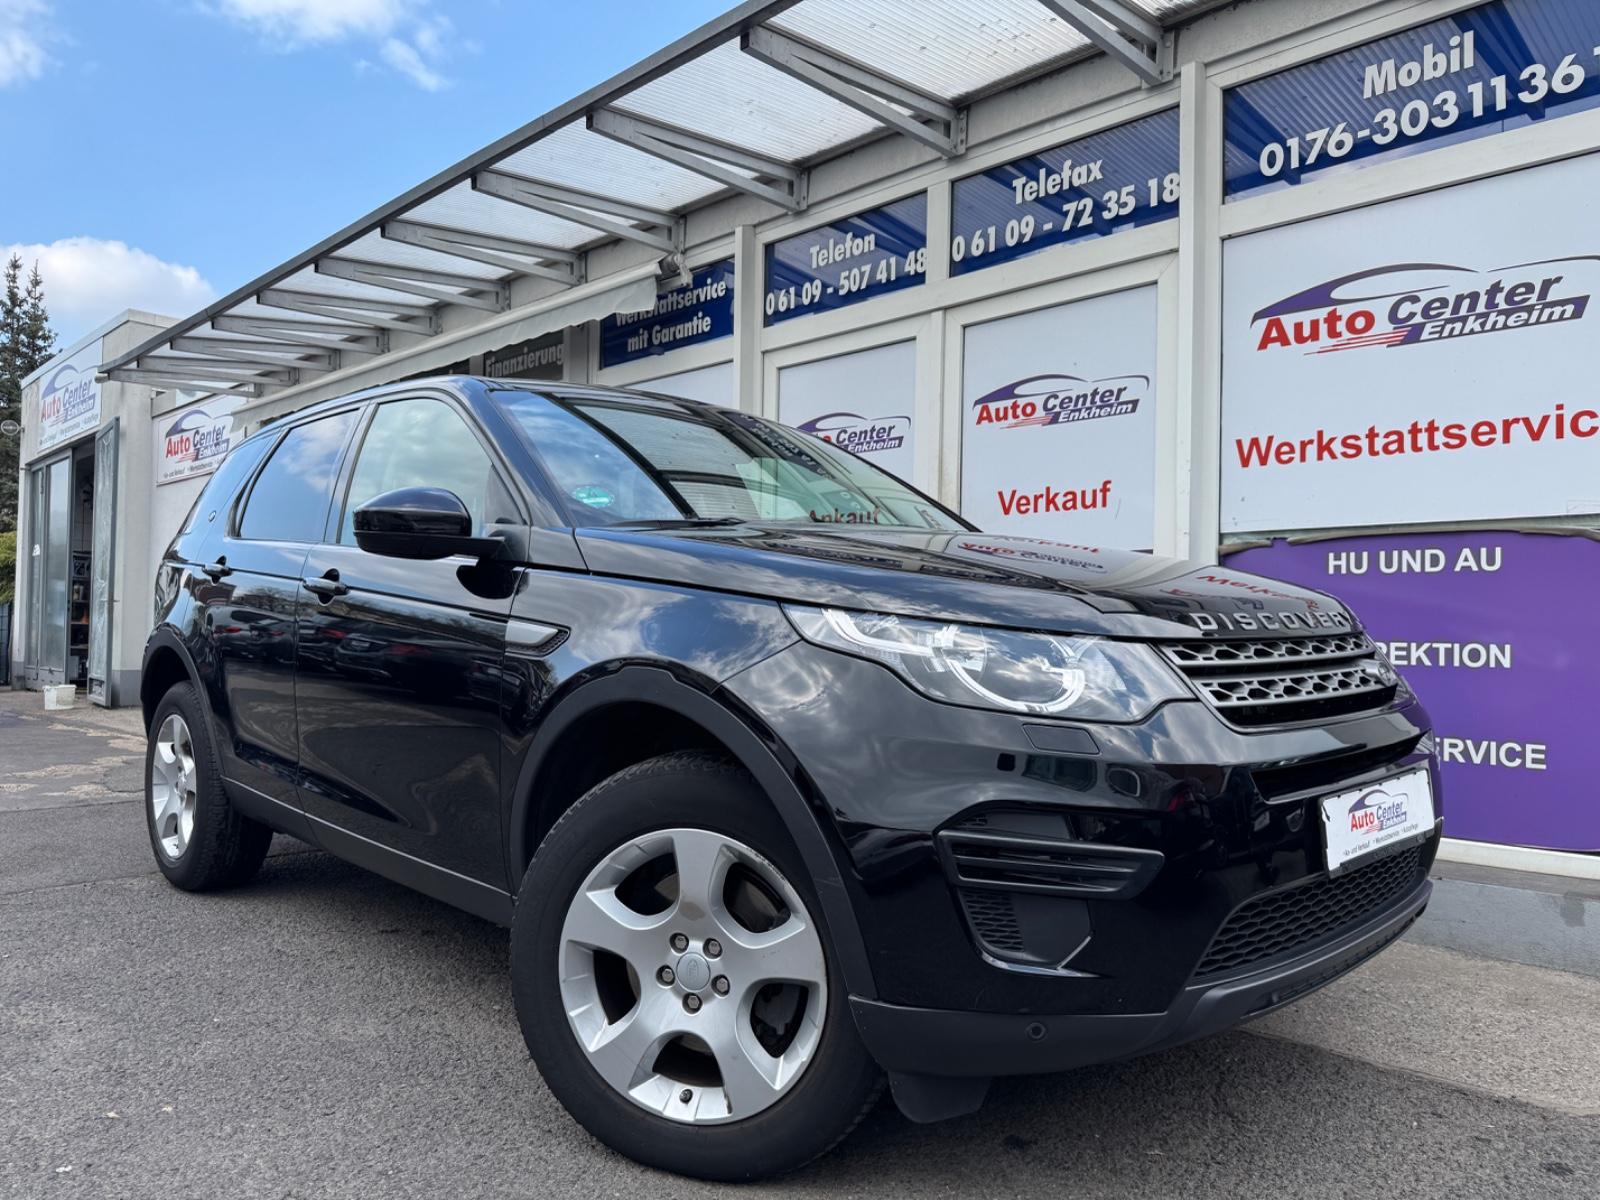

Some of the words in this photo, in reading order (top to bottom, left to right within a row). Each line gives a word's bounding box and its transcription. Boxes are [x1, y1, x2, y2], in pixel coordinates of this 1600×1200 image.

[1363, 30, 1475, 99] Mobil
[1012, 159, 1104, 205] Telefax
[1005, 215, 1035, 247] 09
[1062, 197, 1094, 232] 72
[1102, 185, 1136, 220] 35
[1147, 172, 1180, 208] 18
[809, 232, 876, 269] Telefon
[801, 279, 822, 306] 09
[838, 263, 872, 296] 507
[876, 256, 896, 283] 41
[904, 247, 928, 275] 48
[627, 327, 649, 352] mit
[651, 311, 712, 345] Garantie
[1256, 307, 1376, 351] Auto
[1387, 275, 1564, 326] Center
[1419, 300, 1580, 342] Enkheim
[485, 344, 565, 377] Finanzierung
[41, 395, 61, 423] Auto
[62, 379, 93, 409] Center
[976, 400, 1037, 425] Auto
[1042, 386, 1128, 412] Center
[1058, 402, 1133, 422] Enkheim
[166, 435, 191, 459] Auto
[193, 425, 226, 448] Center
[836, 425, 896, 444] Center
[847, 439, 899, 453] Enkheim
[1235, 403, 1600, 468] Werkstattservic
[998, 480, 1112, 516] Verkauf
[1328, 551, 1369, 575] HU
[1379, 549, 1446, 574] UND
[1454, 546, 1502, 572] AU
[1350, 810, 1375, 832] Auto
[1376, 801, 1404, 820] Center
